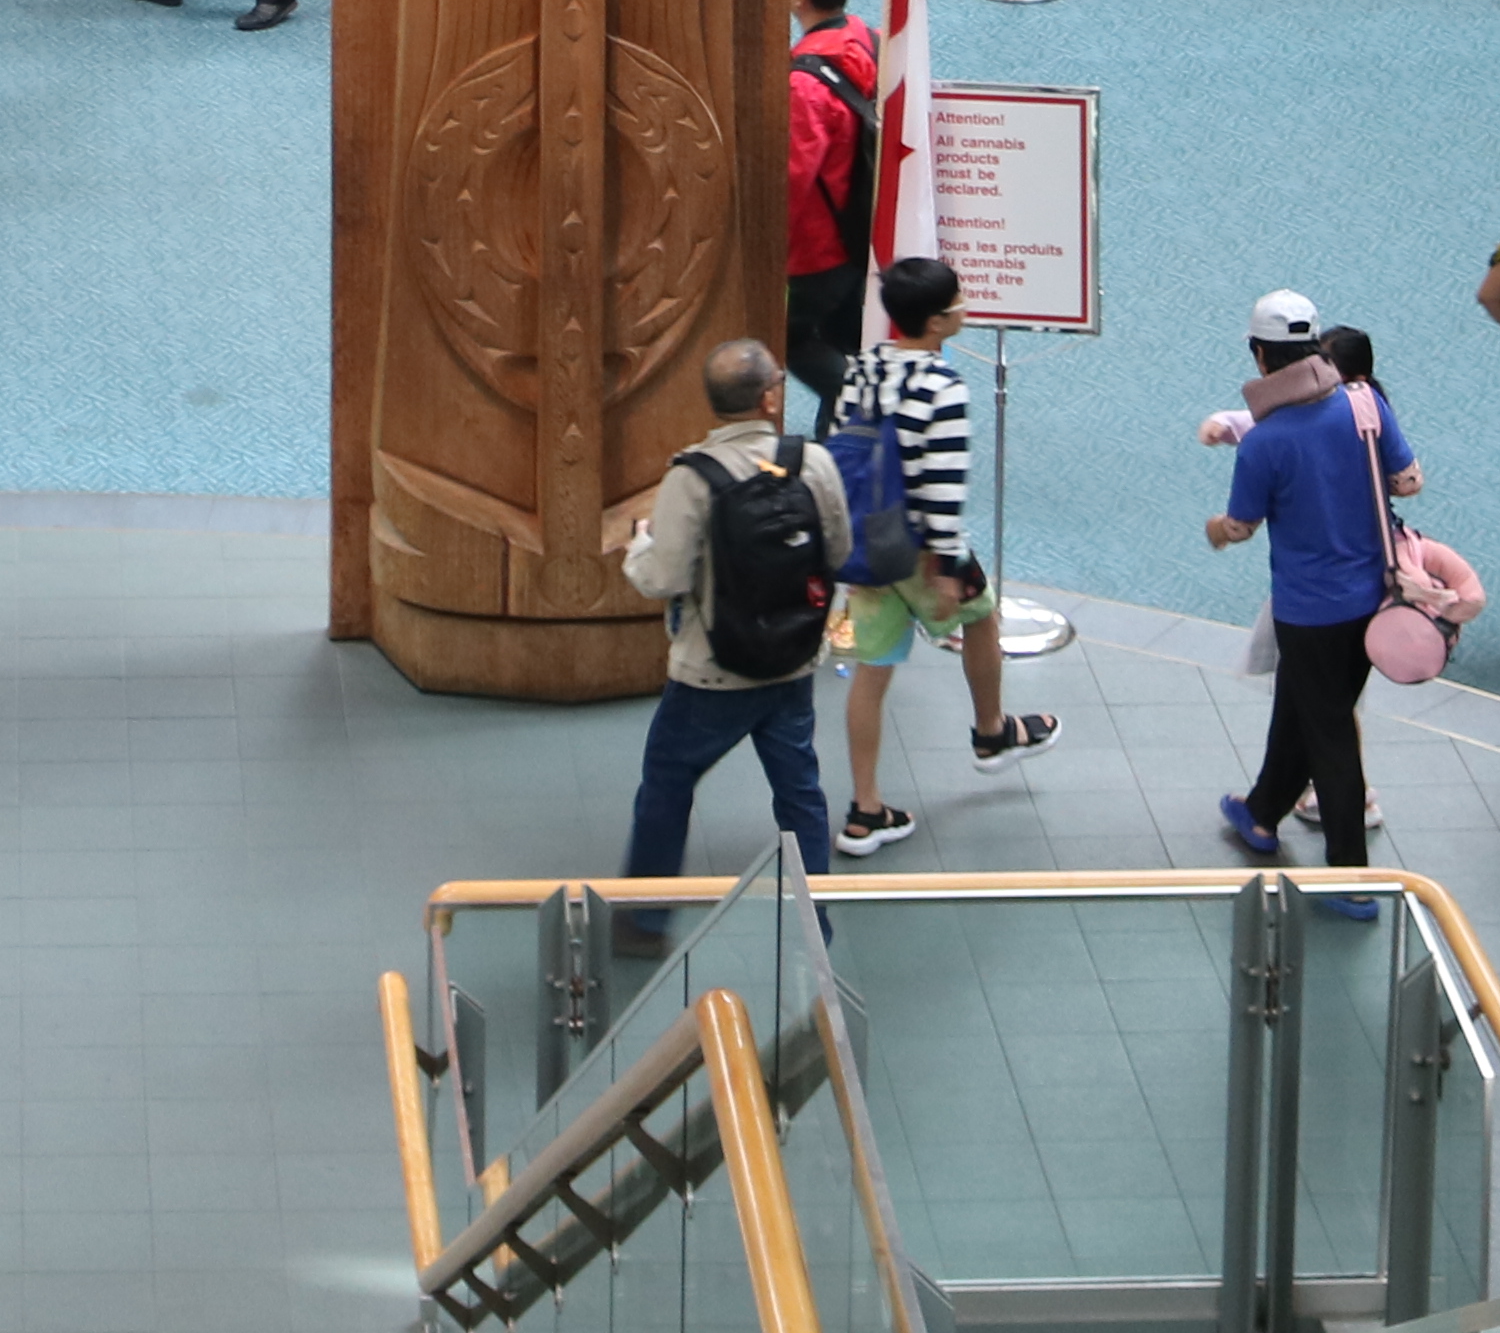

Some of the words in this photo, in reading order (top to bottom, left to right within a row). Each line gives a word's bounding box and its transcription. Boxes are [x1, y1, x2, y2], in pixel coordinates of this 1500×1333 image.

[935, 112, 1005, 126] Attention!
[936, 135, 954, 147] All
[961, 137, 1026, 150] cannabis
[936, 152, 999, 165] products
[936, 169, 971, 180] must
[978, 169, 995, 180] be
[937, 183, 1002, 196] declared.
[938, 215, 1005, 229] Attention!
[938, 238, 970, 251] Tous
[977, 240, 997, 253] les
[1004, 242, 1063, 256] produits
[962, 257, 1026, 269] cannabis
[956, 271, 989, 283] vent
[996, 272, 1023, 285] être
